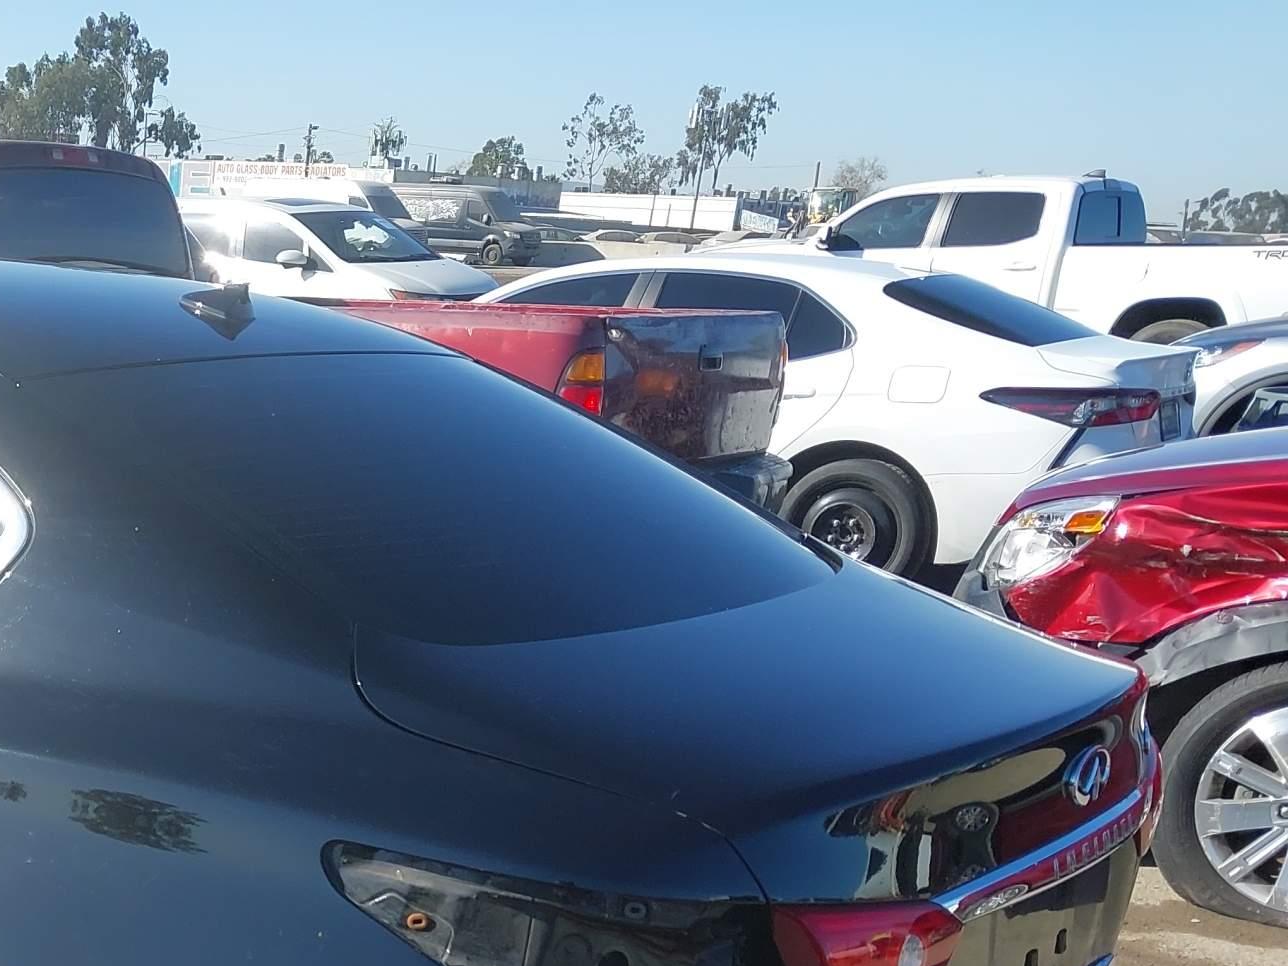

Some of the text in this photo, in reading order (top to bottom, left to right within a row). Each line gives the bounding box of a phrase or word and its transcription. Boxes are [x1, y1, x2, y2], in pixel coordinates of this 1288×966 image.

[217, 164, 234, 174] AUTO
[236, 164, 258, 175] GLASS
[260, 165, 278, 176] BODY
[281, 165, 302, 177] PARTS
[306, 165, 346, 177] ADIATORS
